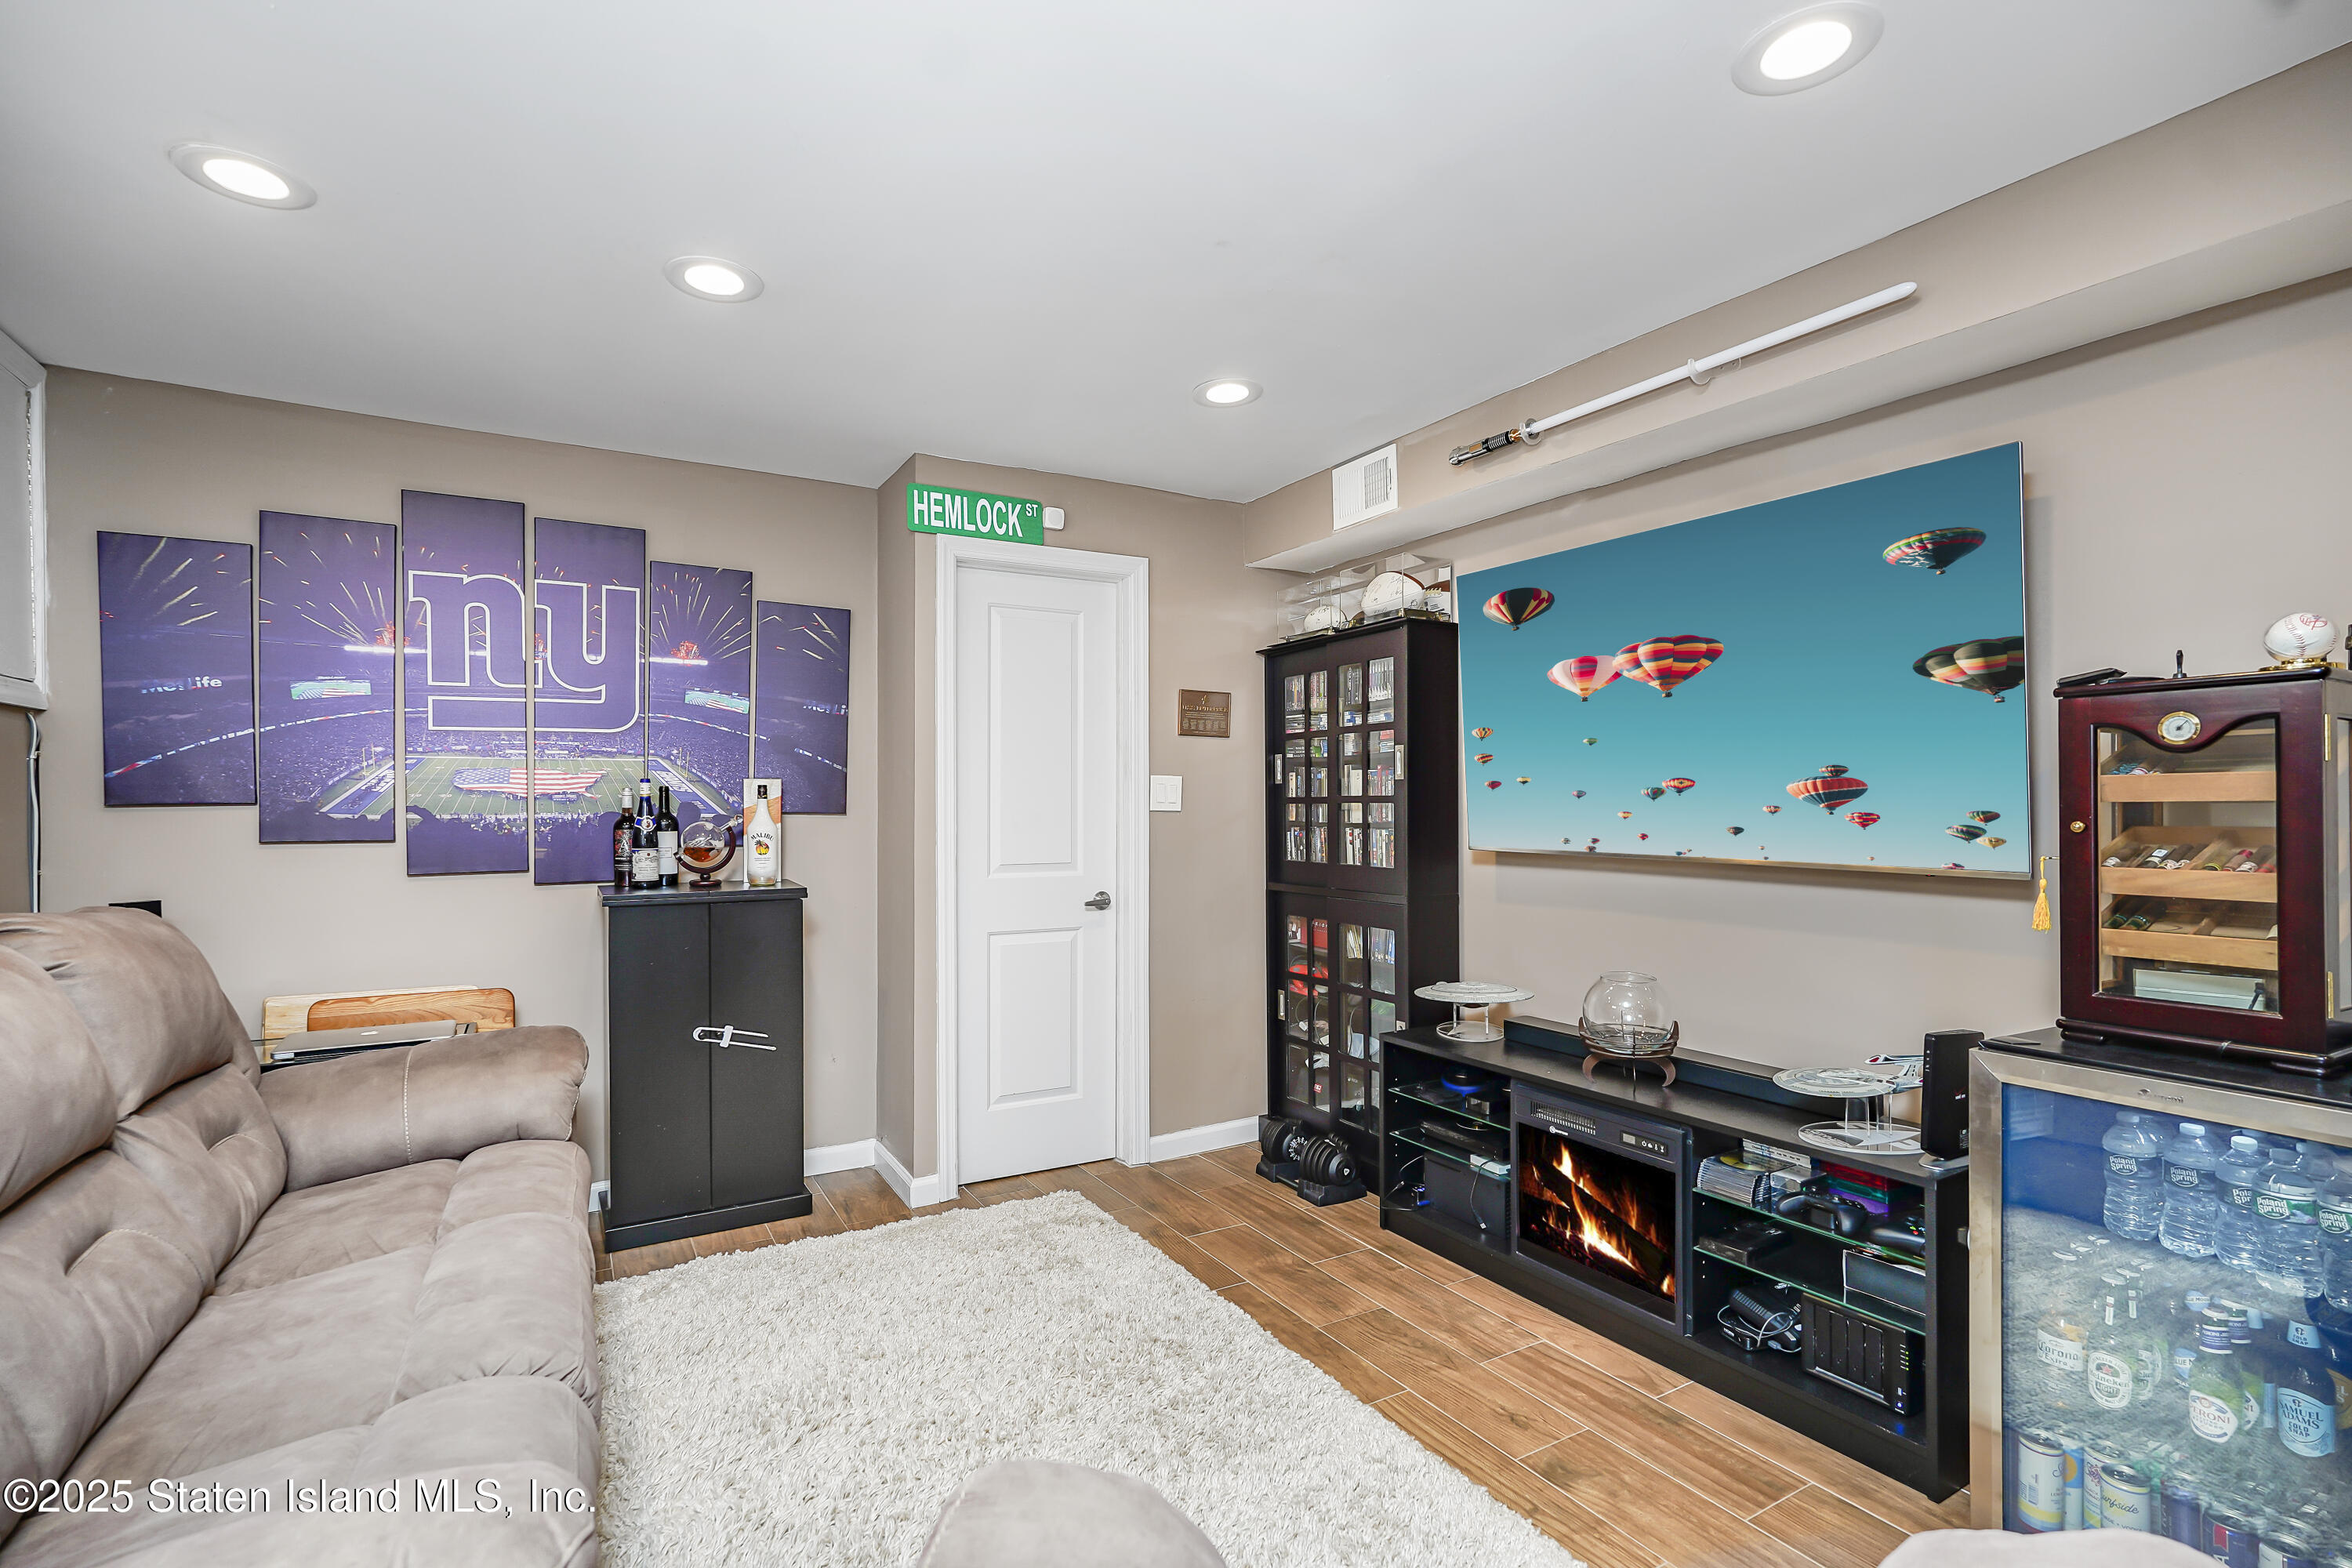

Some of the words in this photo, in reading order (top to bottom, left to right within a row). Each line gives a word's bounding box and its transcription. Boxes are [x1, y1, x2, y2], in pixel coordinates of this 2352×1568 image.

[913, 489, 1024, 538] HEMLOCK
[1025, 503, 1039, 517] ST
[750, 832, 775, 842] MALIBU
[2109, 1156, 2136, 1166] Poland
[2111, 1162, 2137, 1172] Spring
[2170, 1167, 2197, 1177] Poland
[2171, 1174, 2198, 1185] Spring
[2232, 1189, 2252, 1198] Pola
[2234, 1196, 2252, 1205] Spr
[2256, 1196, 2288, 1208] Poland
[2257, 1204, 2290, 1216] Spring
[2319, 1210, 2347, 1223] Poland
[2320, 1218, 2350, 1231] Spring
[2038, 1340, 2079, 1361] Corona
[2045, 1353, 2068, 1367] Extra
[2089, 1368, 2132, 1388] Heineken
[2096, 1383, 2120, 1395] LIGHT
[2190, 1403, 2231, 1425] PERONI
[2278, 1400, 2325, 1422] SAMUEL
[2282, 1409, 2321, 1429] ADAMS
[2288, 1421, 2309, 1433] COLD
[2288, 1427, 2310, 1438] SNAP
[2102, 1493, 2140, 1515] urfside
